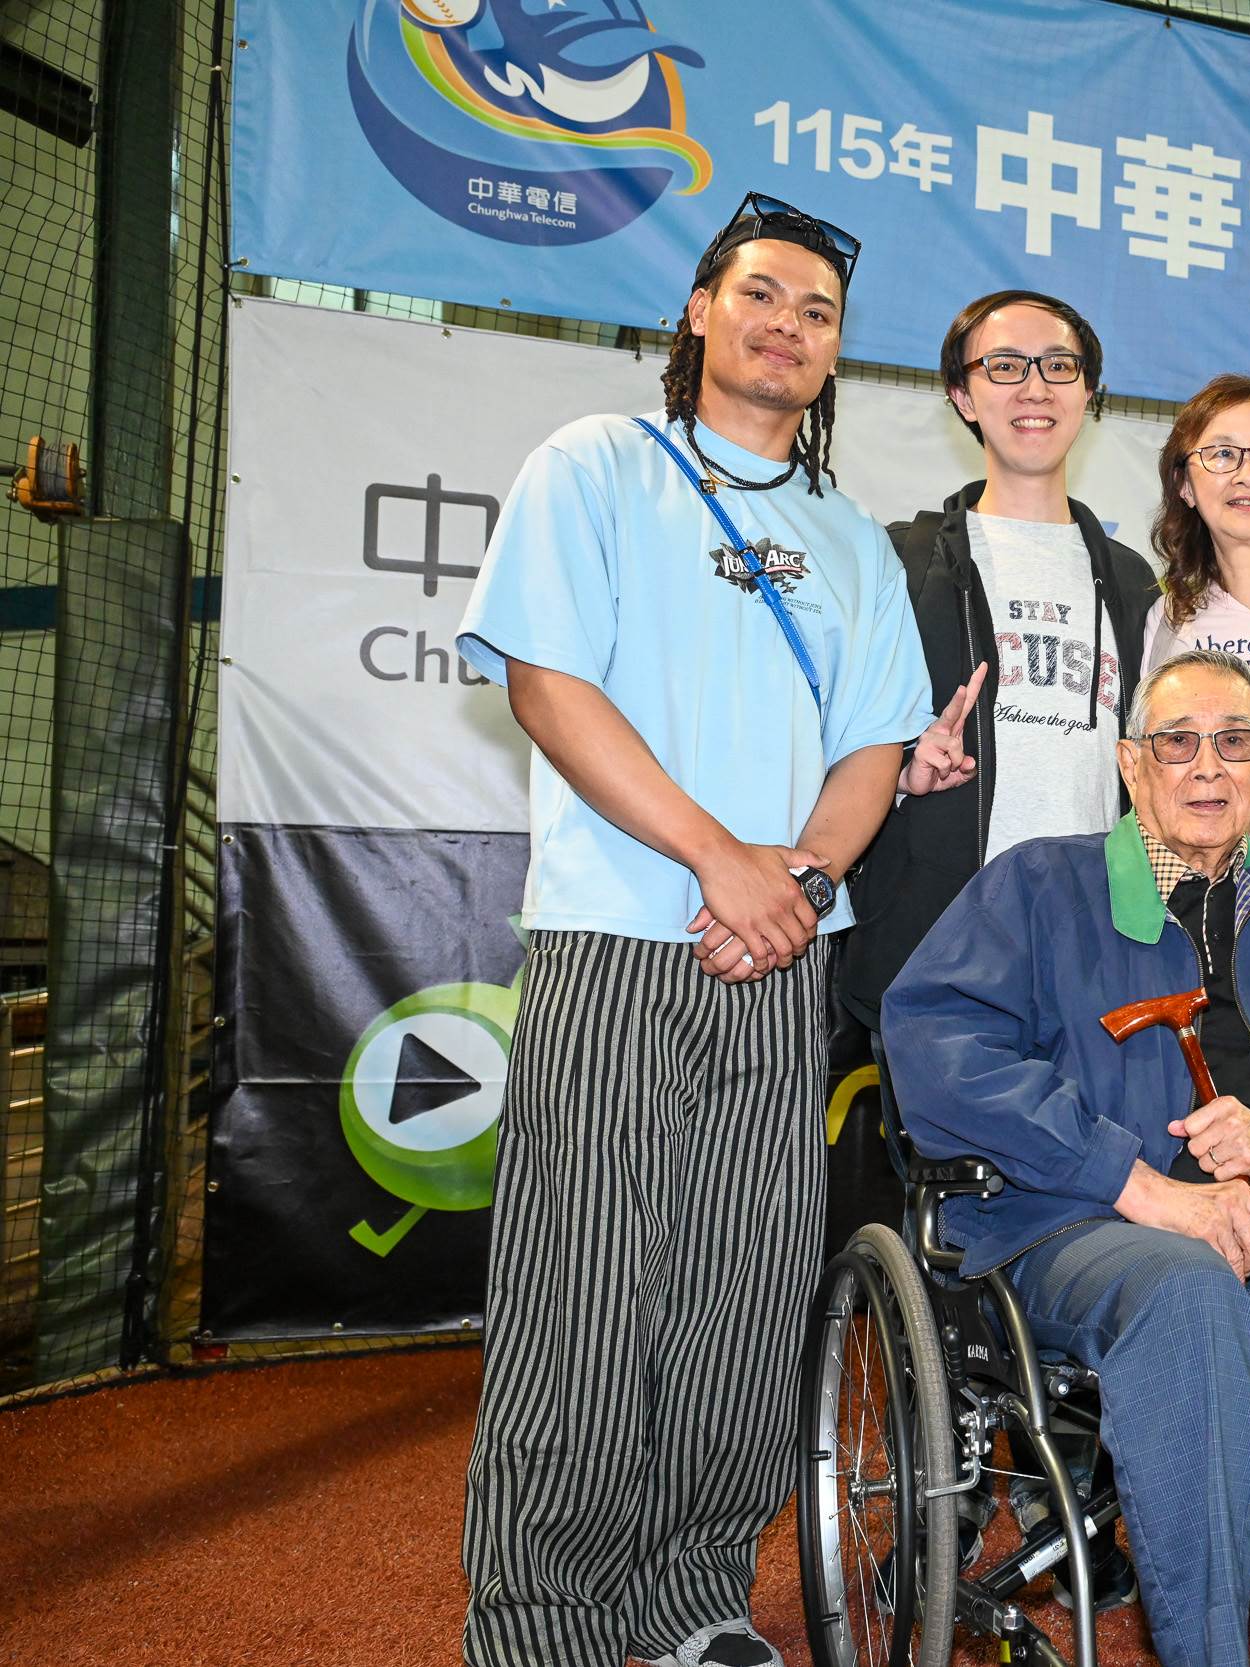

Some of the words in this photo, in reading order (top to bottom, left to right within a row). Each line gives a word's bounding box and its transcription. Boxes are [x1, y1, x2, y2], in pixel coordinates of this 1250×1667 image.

[467, 177, 578, 215] 中華電信
[467, 202, 529, 221] Chunghwa
[529, 211, 576, 230] Telecom
[363, 473, 501, 598] 中
[722, 552, 763, 577] JUN
[765, 549, 802, 569] ARC
[1008, 599, 1072, 625] STAY
[359, 626, 507, 688] Chu
[994, 631, 1120, 718] CUSE
[993, 701, 1046, 725] Achieve
[1047, 712, 1067, 727] the
[1064, 718, 1094, 736] goa
